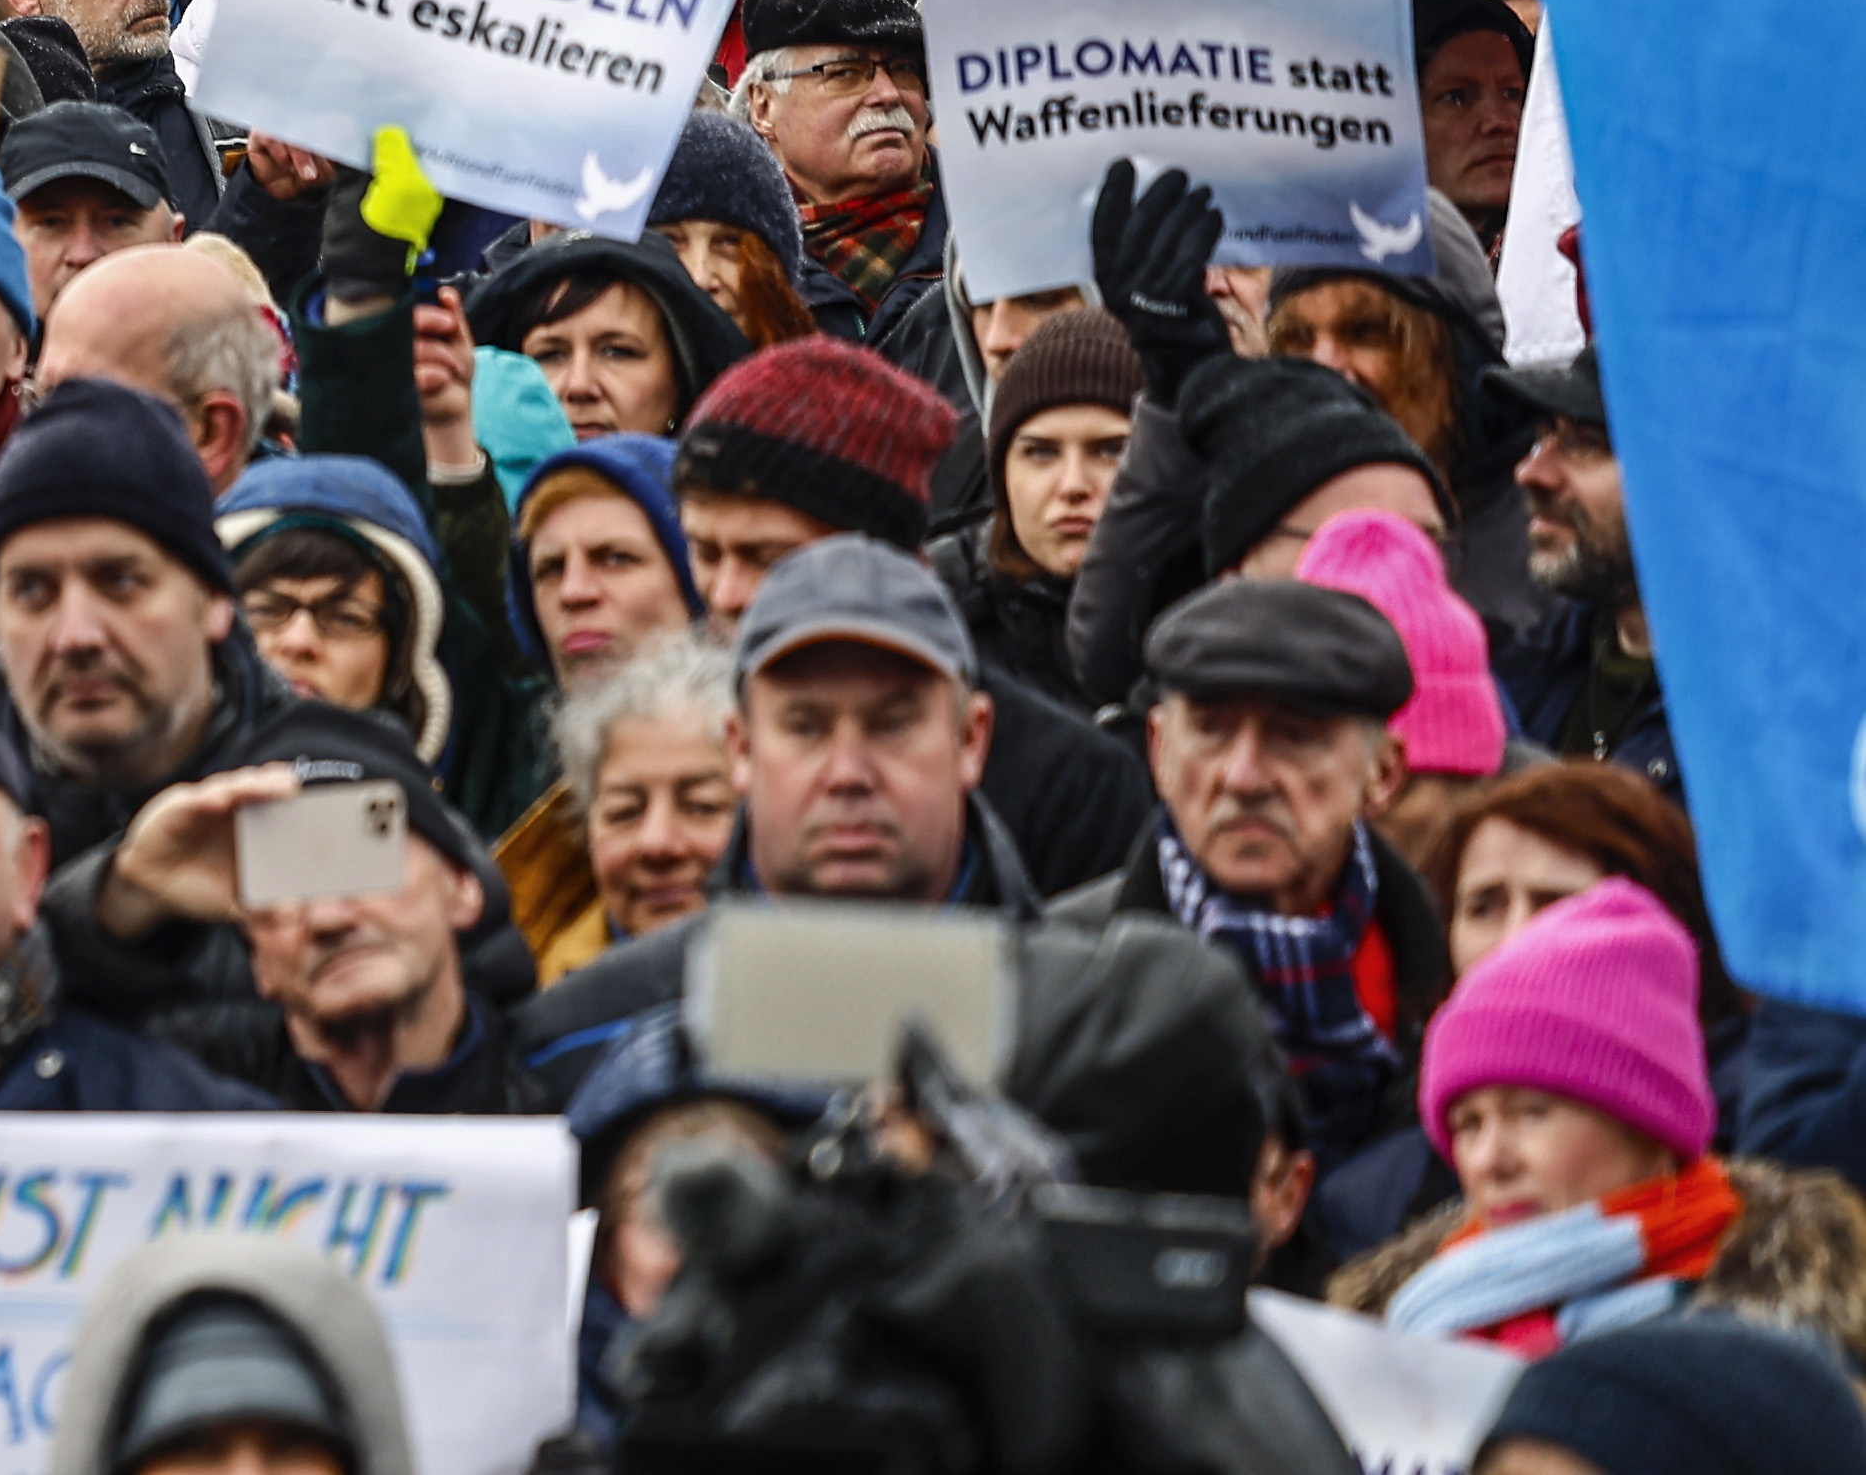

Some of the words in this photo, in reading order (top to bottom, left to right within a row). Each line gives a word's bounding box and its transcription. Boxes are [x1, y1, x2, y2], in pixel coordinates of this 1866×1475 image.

[956, 39, 1273, 94] DIPLOMATIE
[1287, 57, 1394, 98] statt
[968, 91, 1393, 151] Waffenlieferungen
